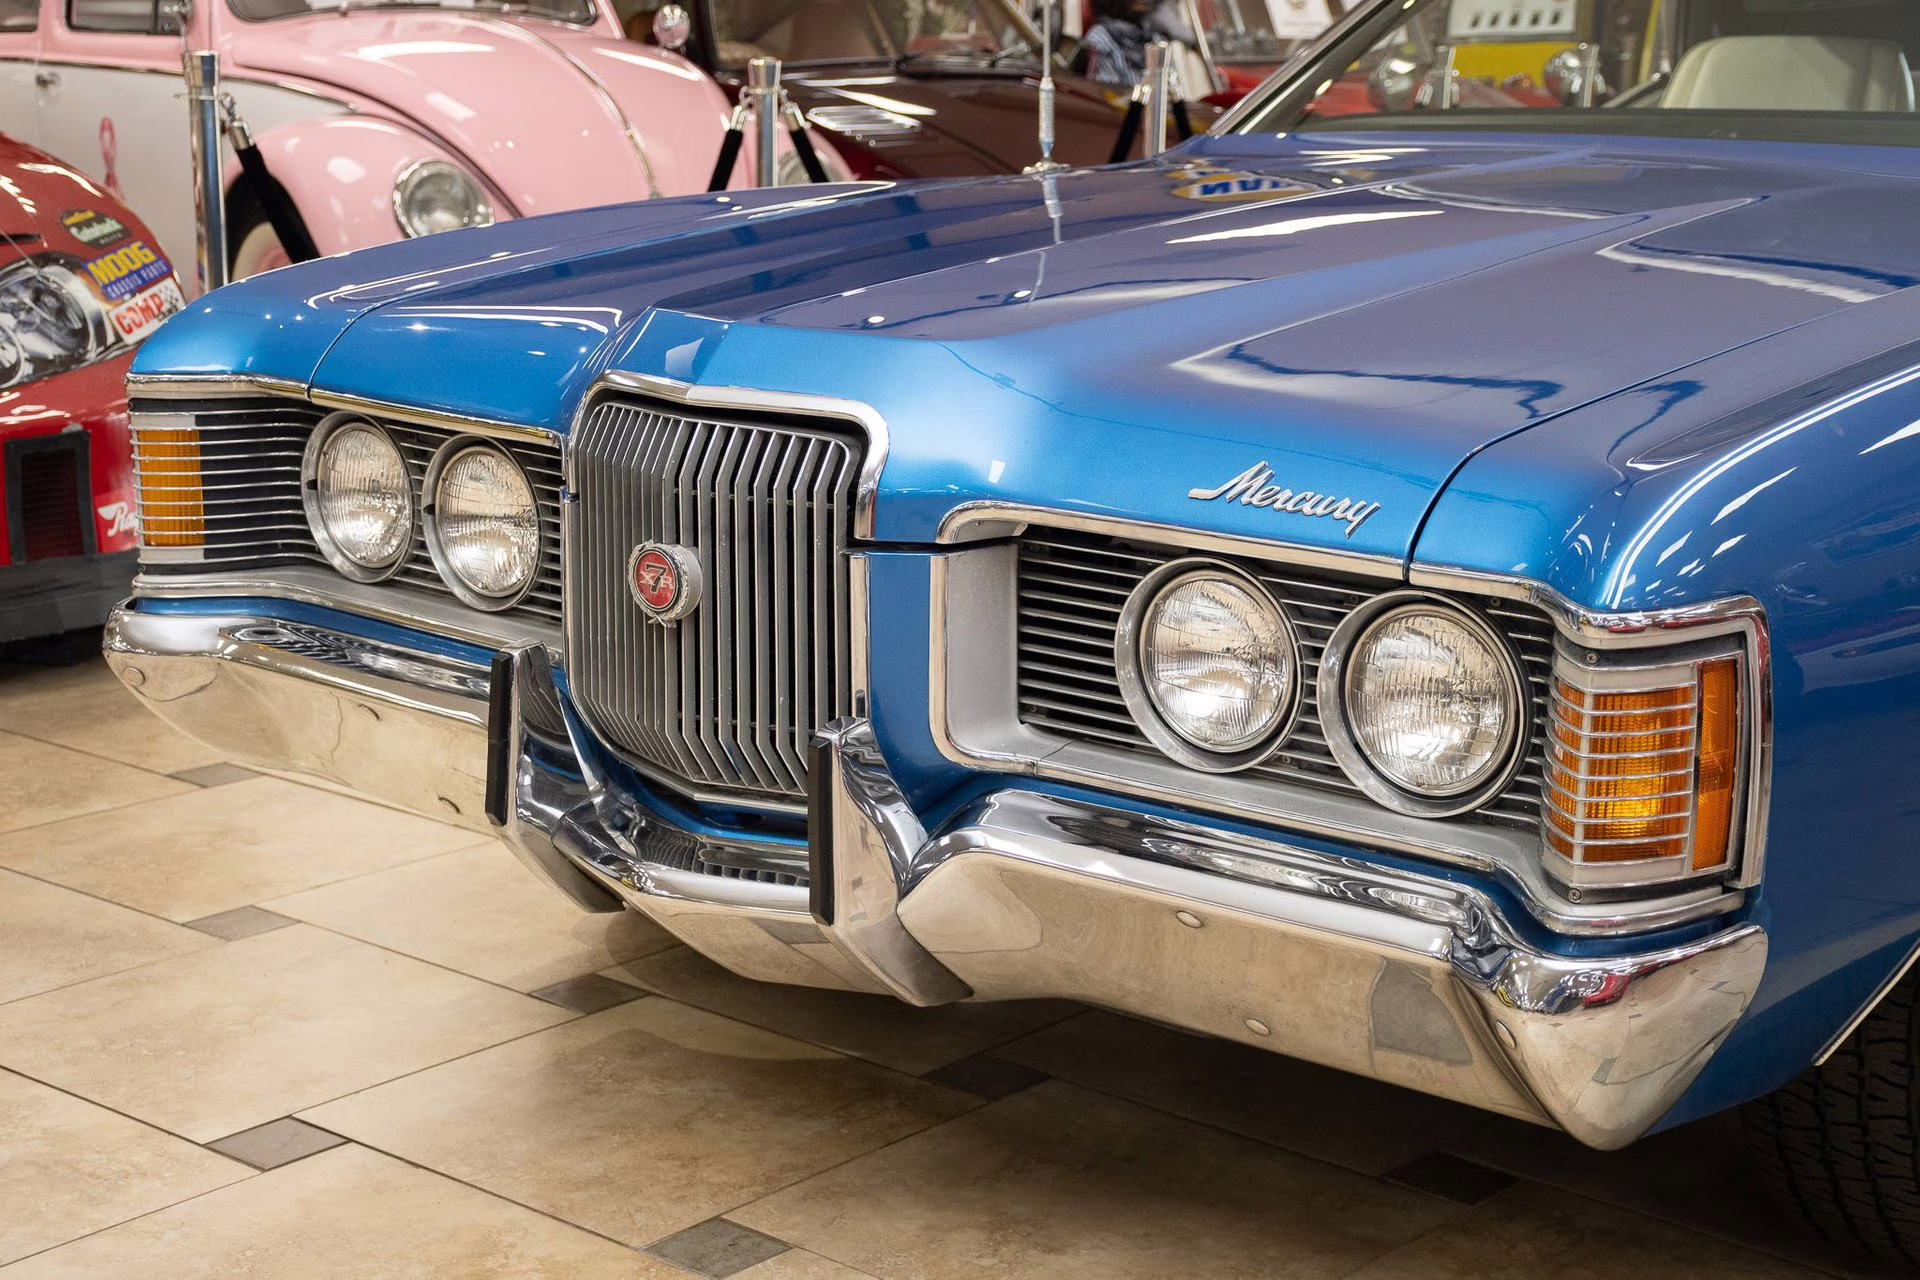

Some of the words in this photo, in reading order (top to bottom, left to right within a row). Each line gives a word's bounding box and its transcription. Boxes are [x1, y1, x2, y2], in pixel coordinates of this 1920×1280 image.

[88, 241, 157, 287] MOOG
[115, 294, 164, 334] COMP
[1188, 460, 1381, 539] Mercury
